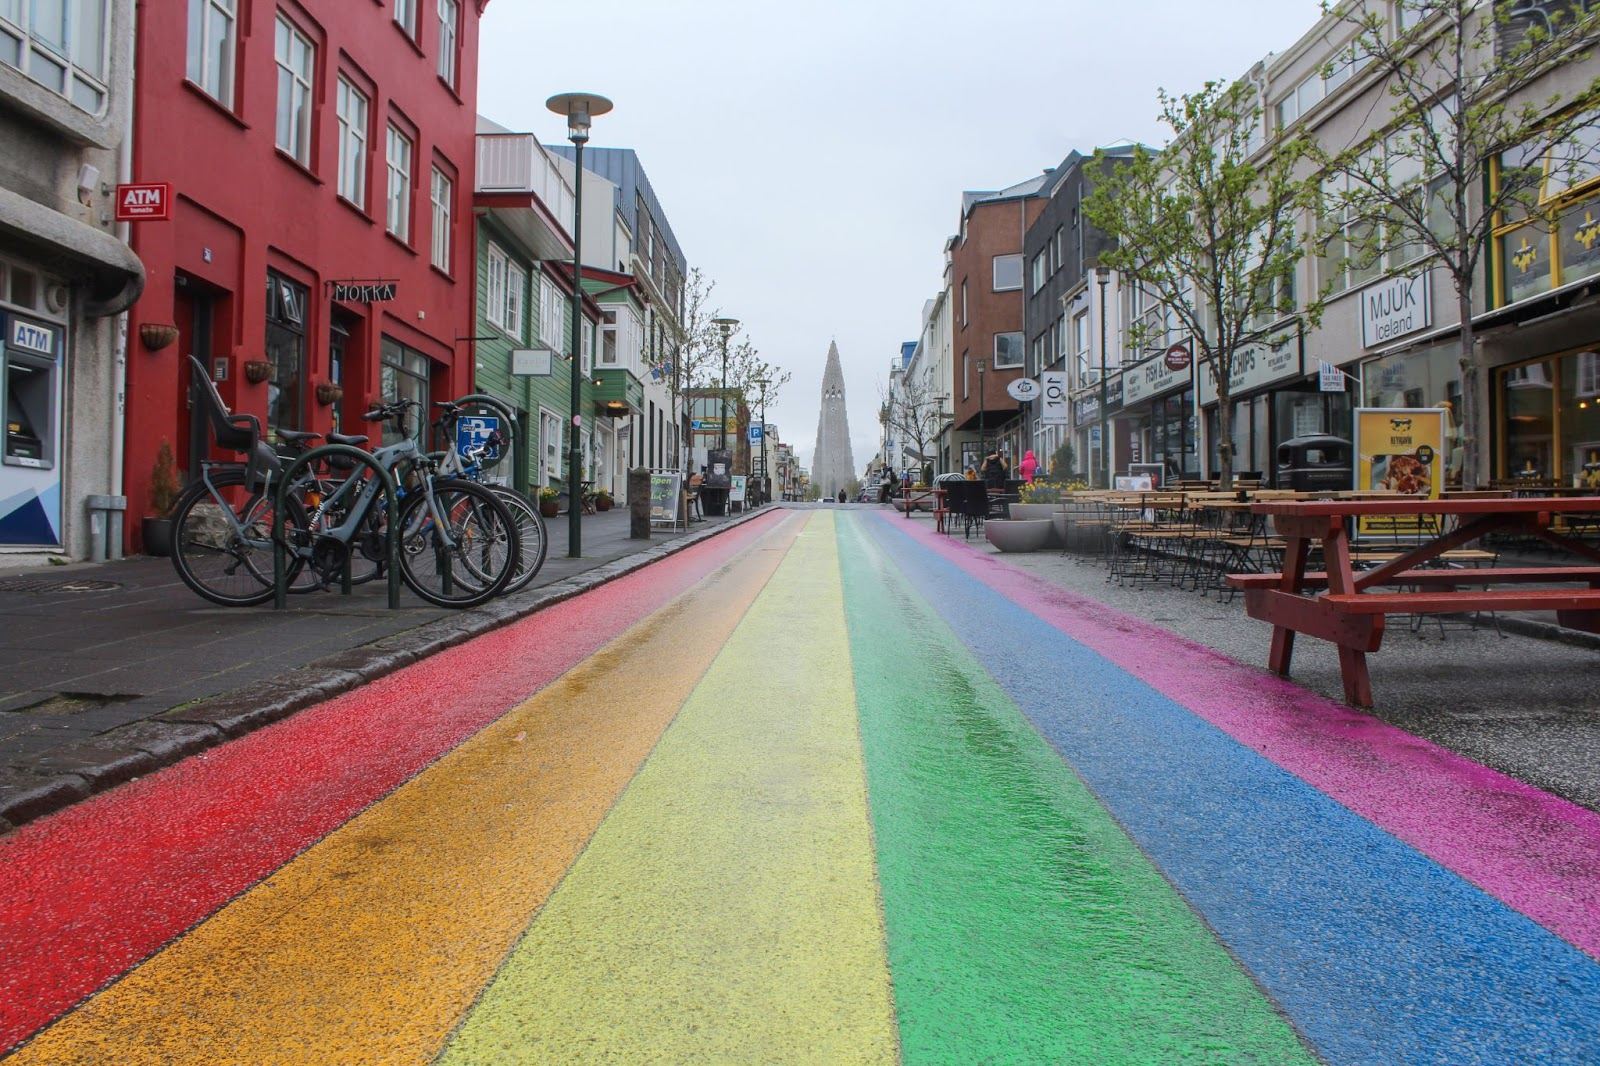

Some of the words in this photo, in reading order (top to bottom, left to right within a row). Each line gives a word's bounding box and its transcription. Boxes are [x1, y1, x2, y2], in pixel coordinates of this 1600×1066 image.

[124, 189, 160, 205] ATM
[336, 284, 394, 304] MOKKA
[1371, 279, 1416, 321] MJÚK
[1376, 311, 1412, 340] Iceland
[16, 326, 47, 350] ATM
[1146, 361, 1157, 384] FISH
[1158, 364, 1163, 378] &
[1232, 348, 1255, 376] CHIPS
[1047, 377, 1061, 407] 101
[753, 428, 760, 436] P
[651, 477, 672, 485] Open
